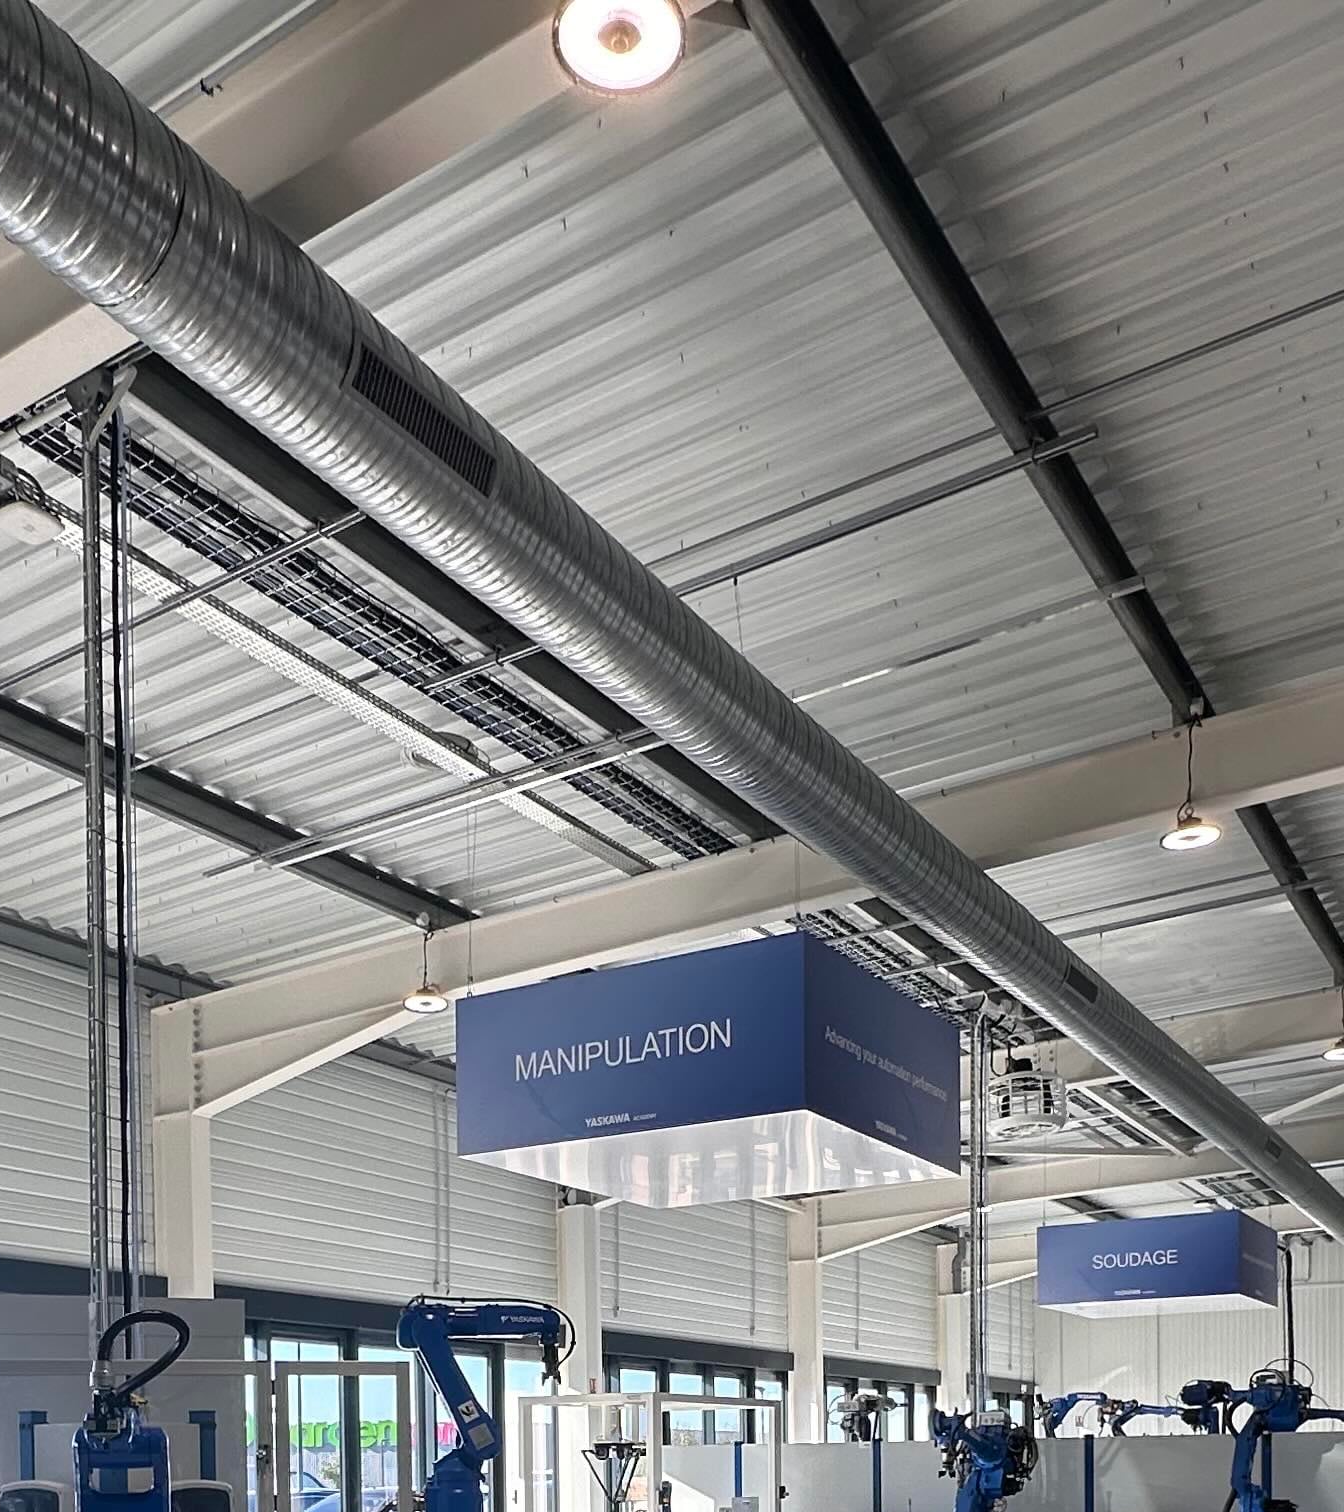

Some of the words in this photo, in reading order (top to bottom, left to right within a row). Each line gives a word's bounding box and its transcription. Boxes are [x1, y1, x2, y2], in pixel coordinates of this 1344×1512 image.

[514, 1018, 732, 1083] MANIPULATION
[585, 1112, 631, 1128] YASKAWA
[1092, 1249, 1179, 1270] SOUDAGE
